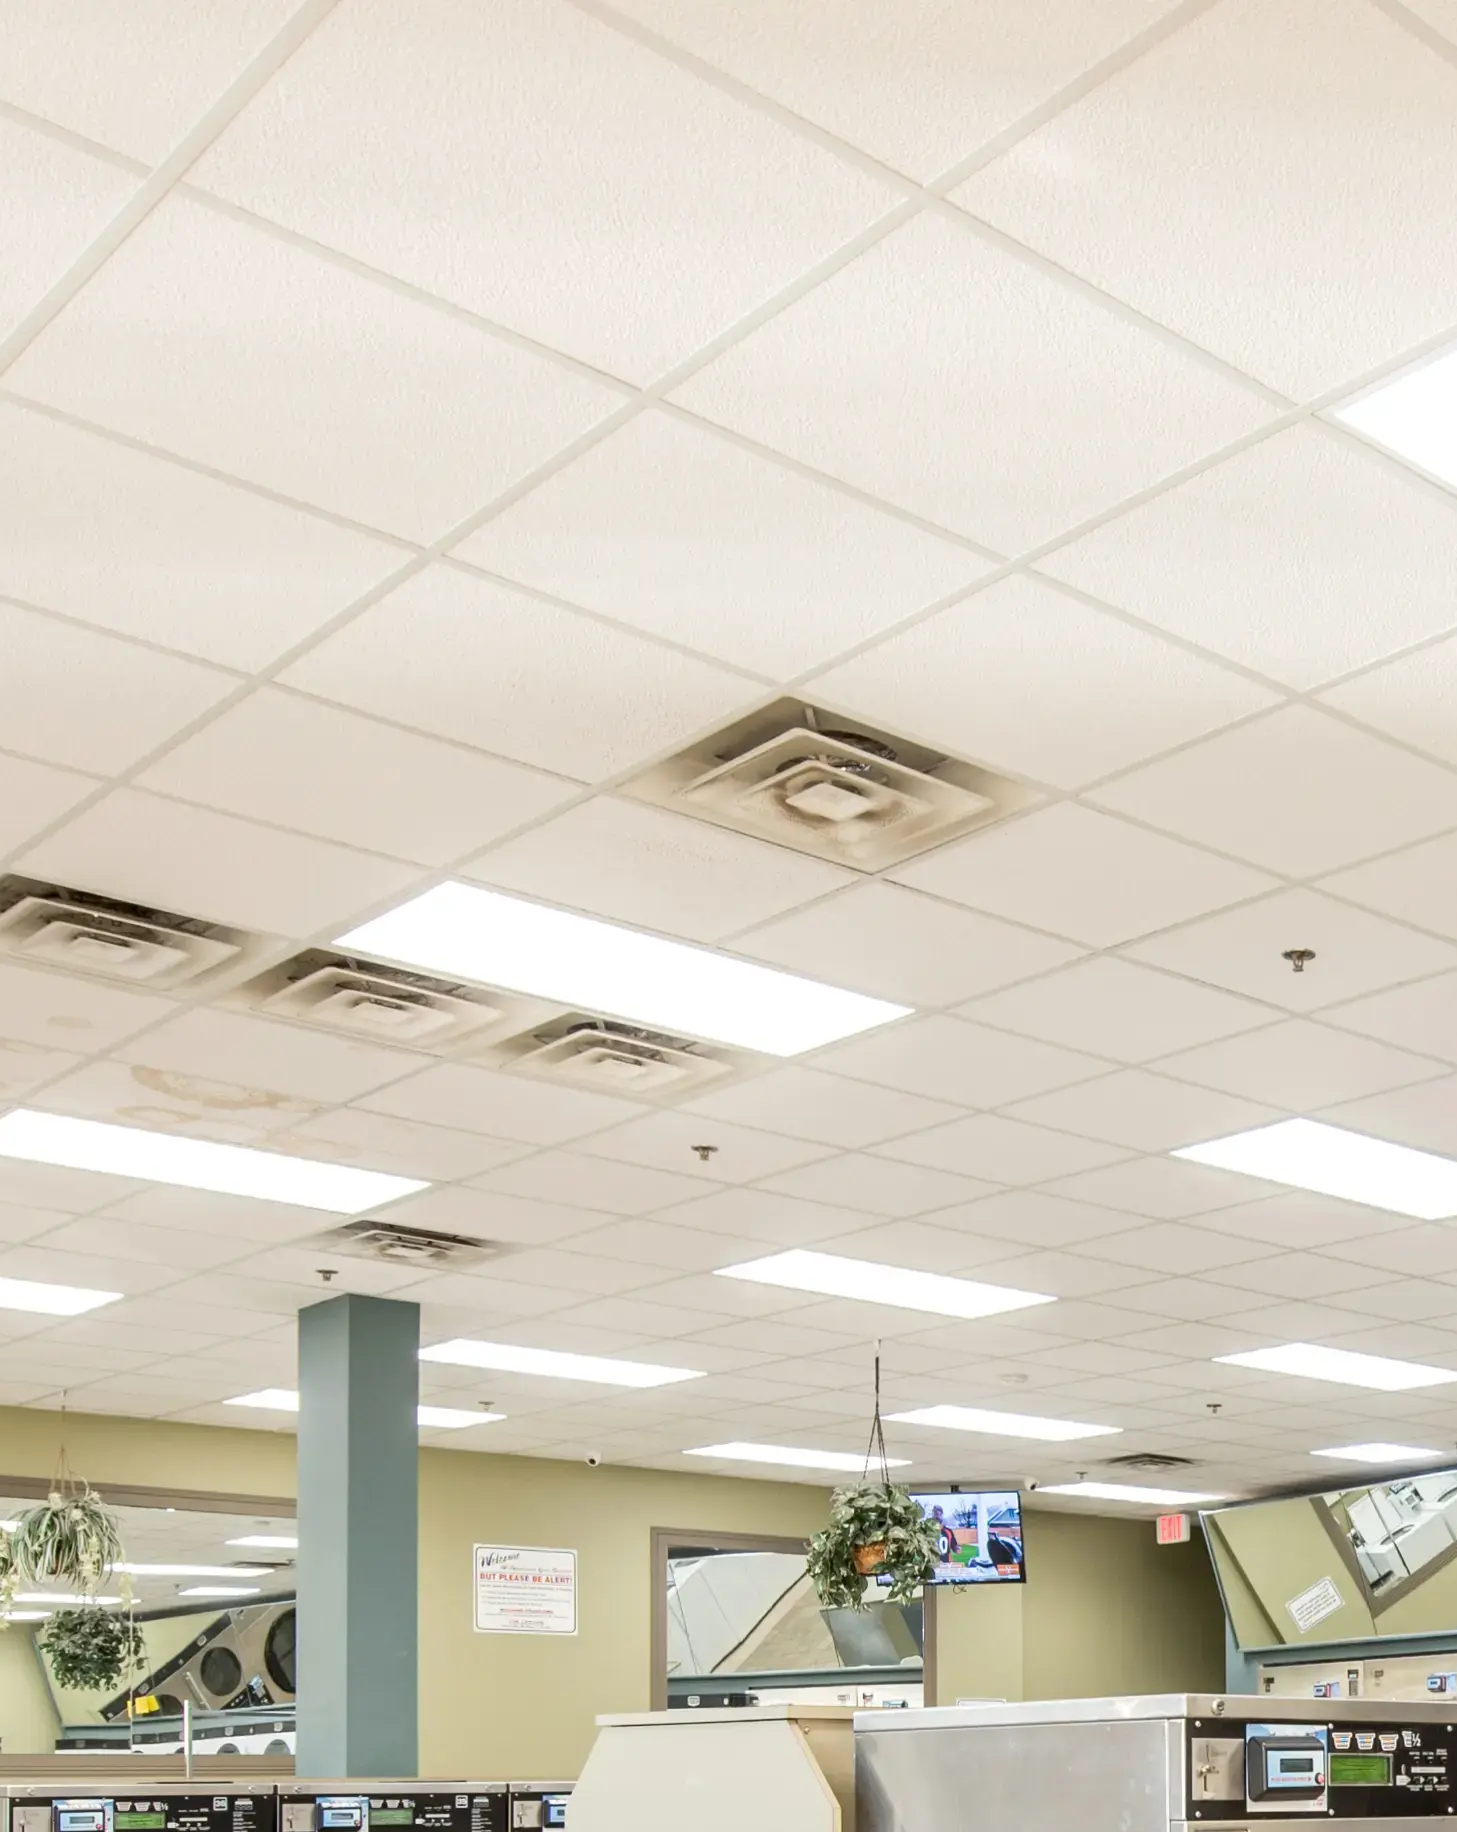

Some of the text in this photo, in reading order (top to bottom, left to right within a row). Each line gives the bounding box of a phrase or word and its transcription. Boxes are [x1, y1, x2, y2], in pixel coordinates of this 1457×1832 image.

[1160, 1515, 1182, 1543] EXIT
[480, 1572, 496, 1580] BUT
[499, 1574, 529, 1582] PLEASE
